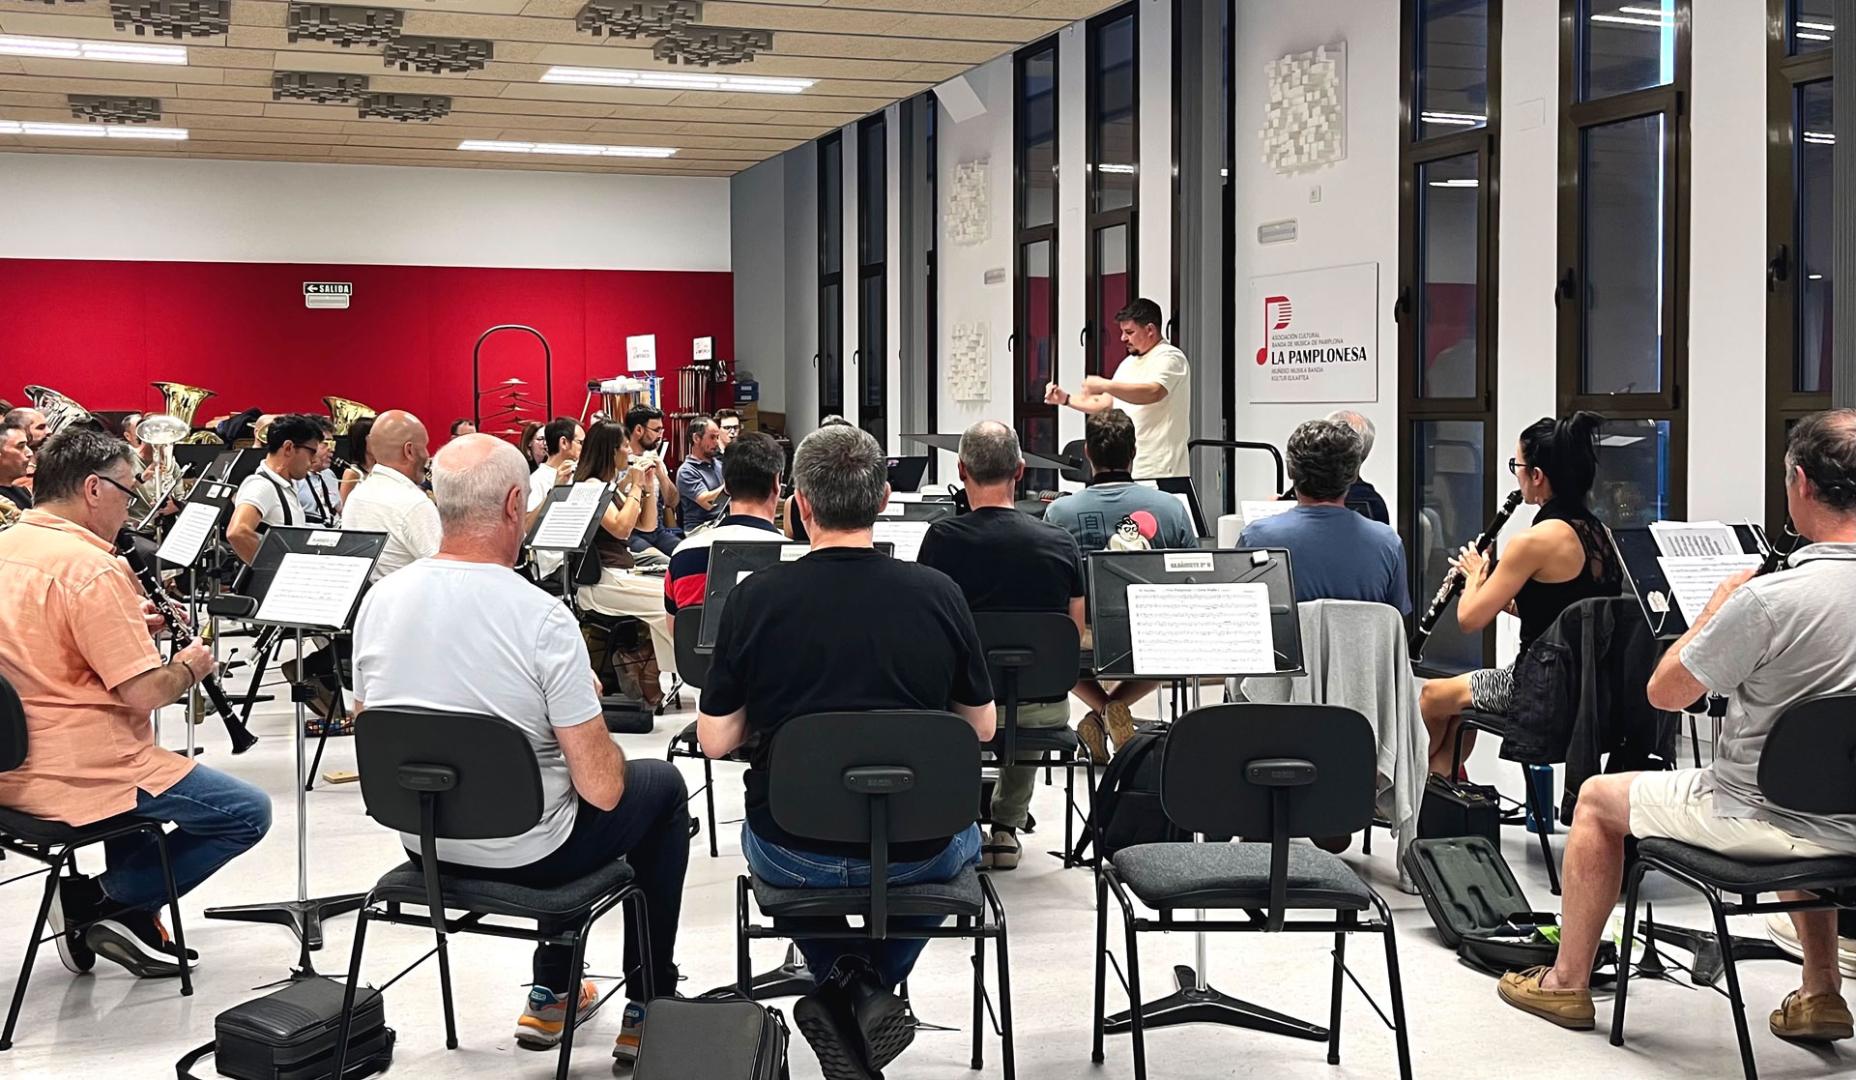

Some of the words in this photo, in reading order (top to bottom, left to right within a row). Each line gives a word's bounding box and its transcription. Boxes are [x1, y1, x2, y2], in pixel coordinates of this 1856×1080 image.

[319, 284, 349, 293] SALIDA
[1299, 332, 1320, 340] CULTURAL
[1318, 338, 1344, 346] PAMPLONA
[1271, 351, 1285, 365] LA
[1289, 346, 1367, 364] PAMPLONESA
